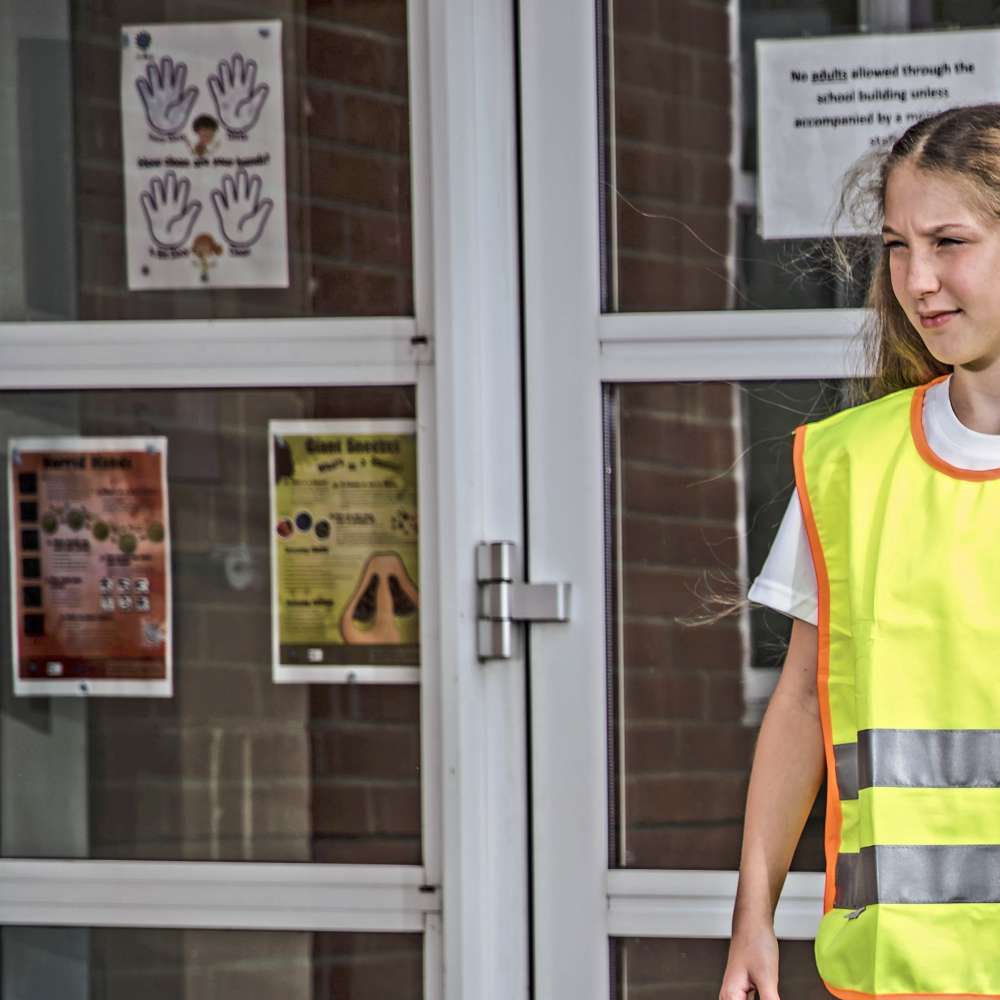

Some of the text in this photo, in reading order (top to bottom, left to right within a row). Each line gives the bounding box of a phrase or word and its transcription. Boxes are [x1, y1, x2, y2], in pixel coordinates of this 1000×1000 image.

[790, 61, 975, 84] No adults allowed through the
[817, 86, 949, 104] school building unless
[794, 113, 874, 129] accompanied
[878, 111, 892, 126] by
[895, 114, 903, 123] a
